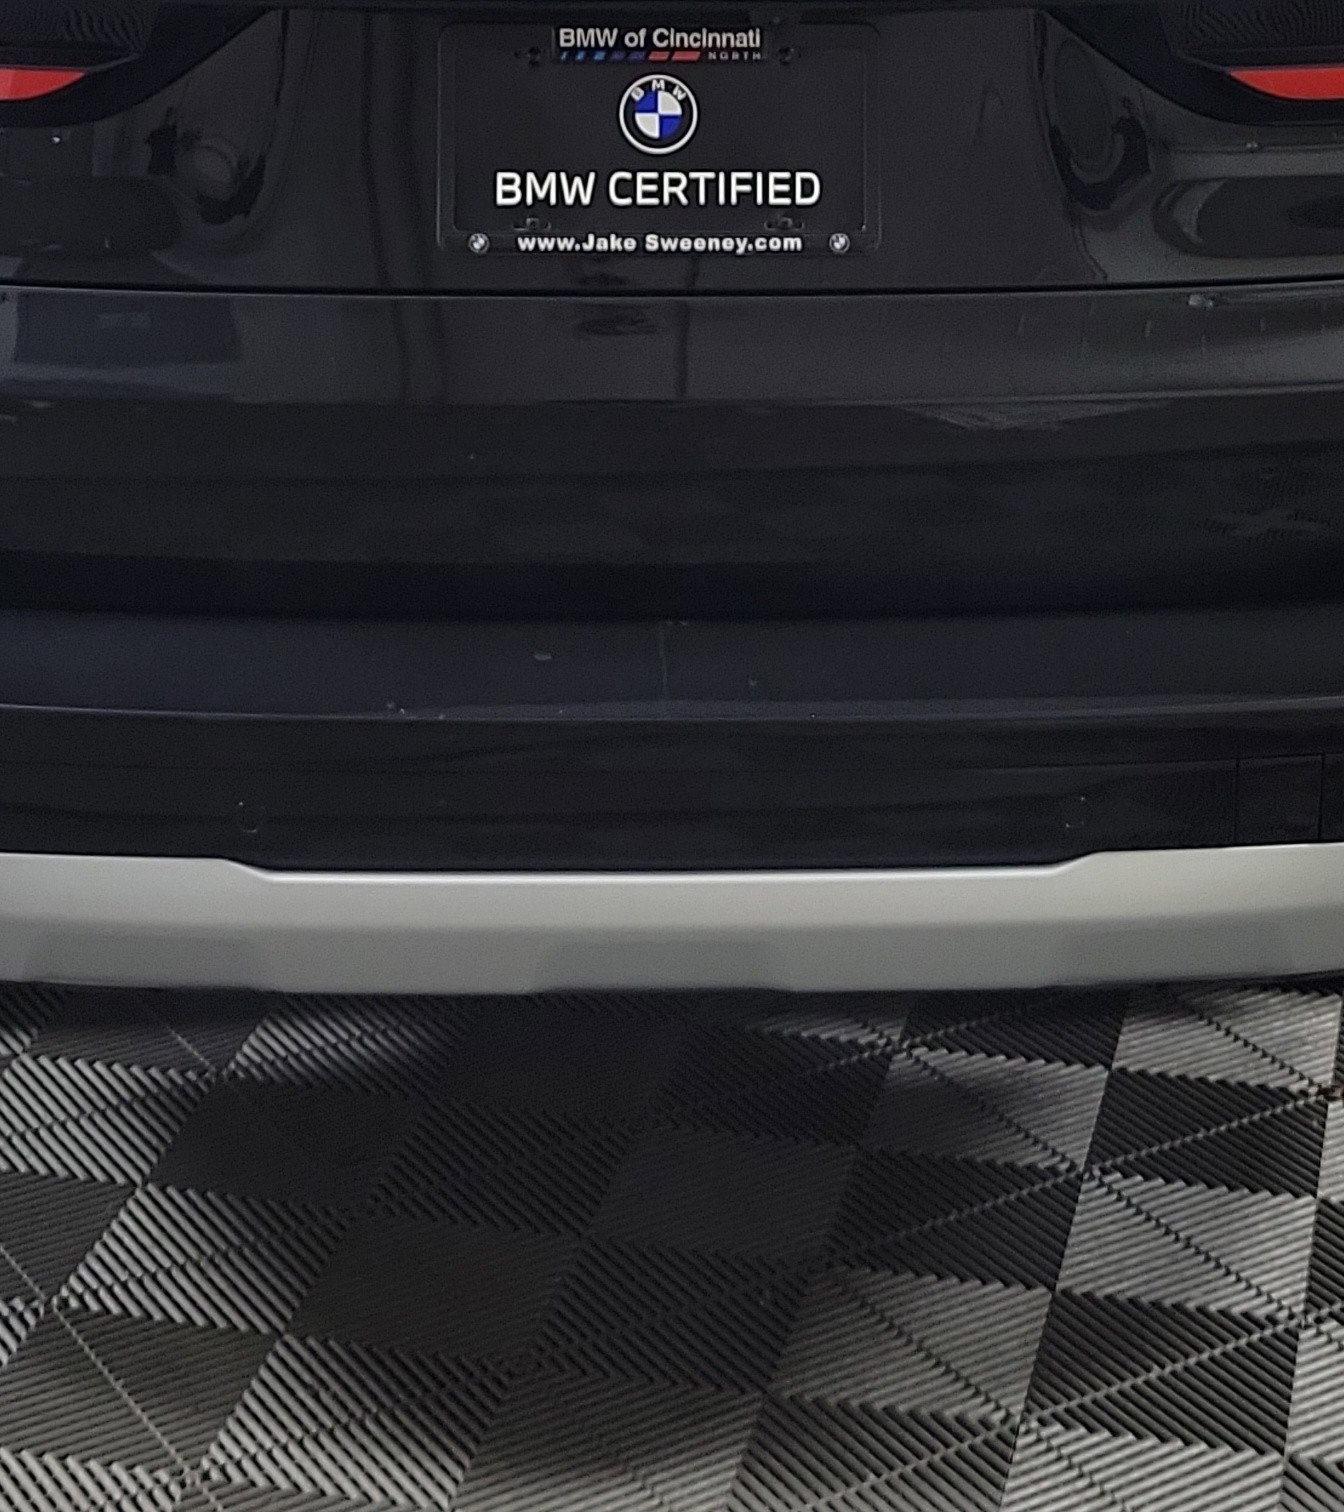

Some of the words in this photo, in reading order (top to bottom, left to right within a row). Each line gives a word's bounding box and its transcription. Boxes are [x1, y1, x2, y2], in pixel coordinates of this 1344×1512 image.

[559, 28, 618, 48] BMW
[624, 28, 647, 48] of
[652, 28, 760, 48] Cincinnati
[708, 51, 762, 61] NORTH
[631, 79, 686, 102] BMW
[495, 172, 596, 205] BMW
[609, 172, 821, 206] CERTIFIED
[517, 235, 636, 252] www.Jake
[644, 234, 802, 254] Sweeney.com
